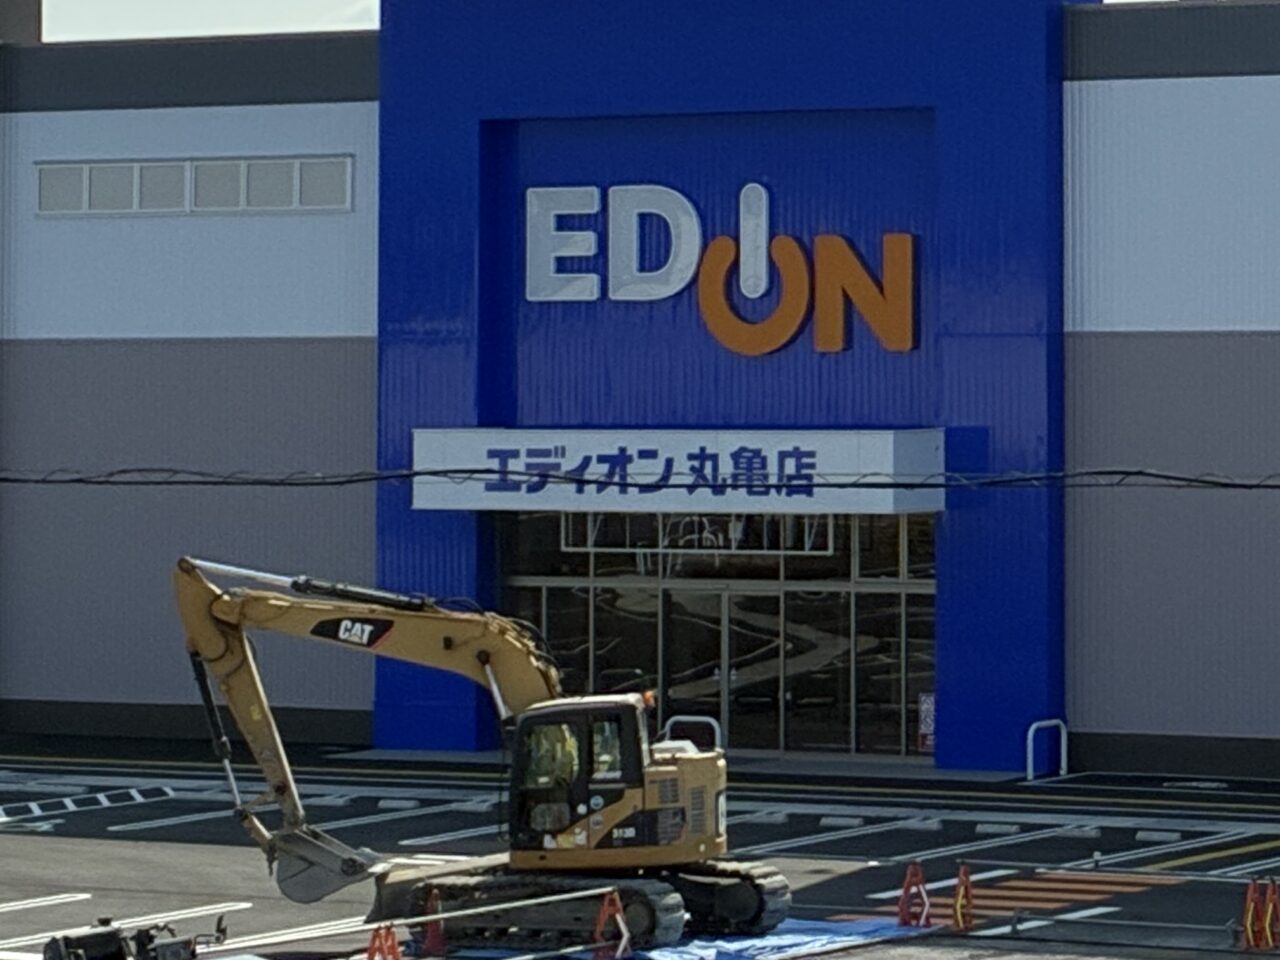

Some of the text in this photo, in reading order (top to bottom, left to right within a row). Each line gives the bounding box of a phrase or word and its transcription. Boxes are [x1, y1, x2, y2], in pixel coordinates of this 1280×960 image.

[525, 182, 914, 357] EDION
[484, 445, 817, 498] エディオン丸亀店
[338, 619, 374, 645] CAT
